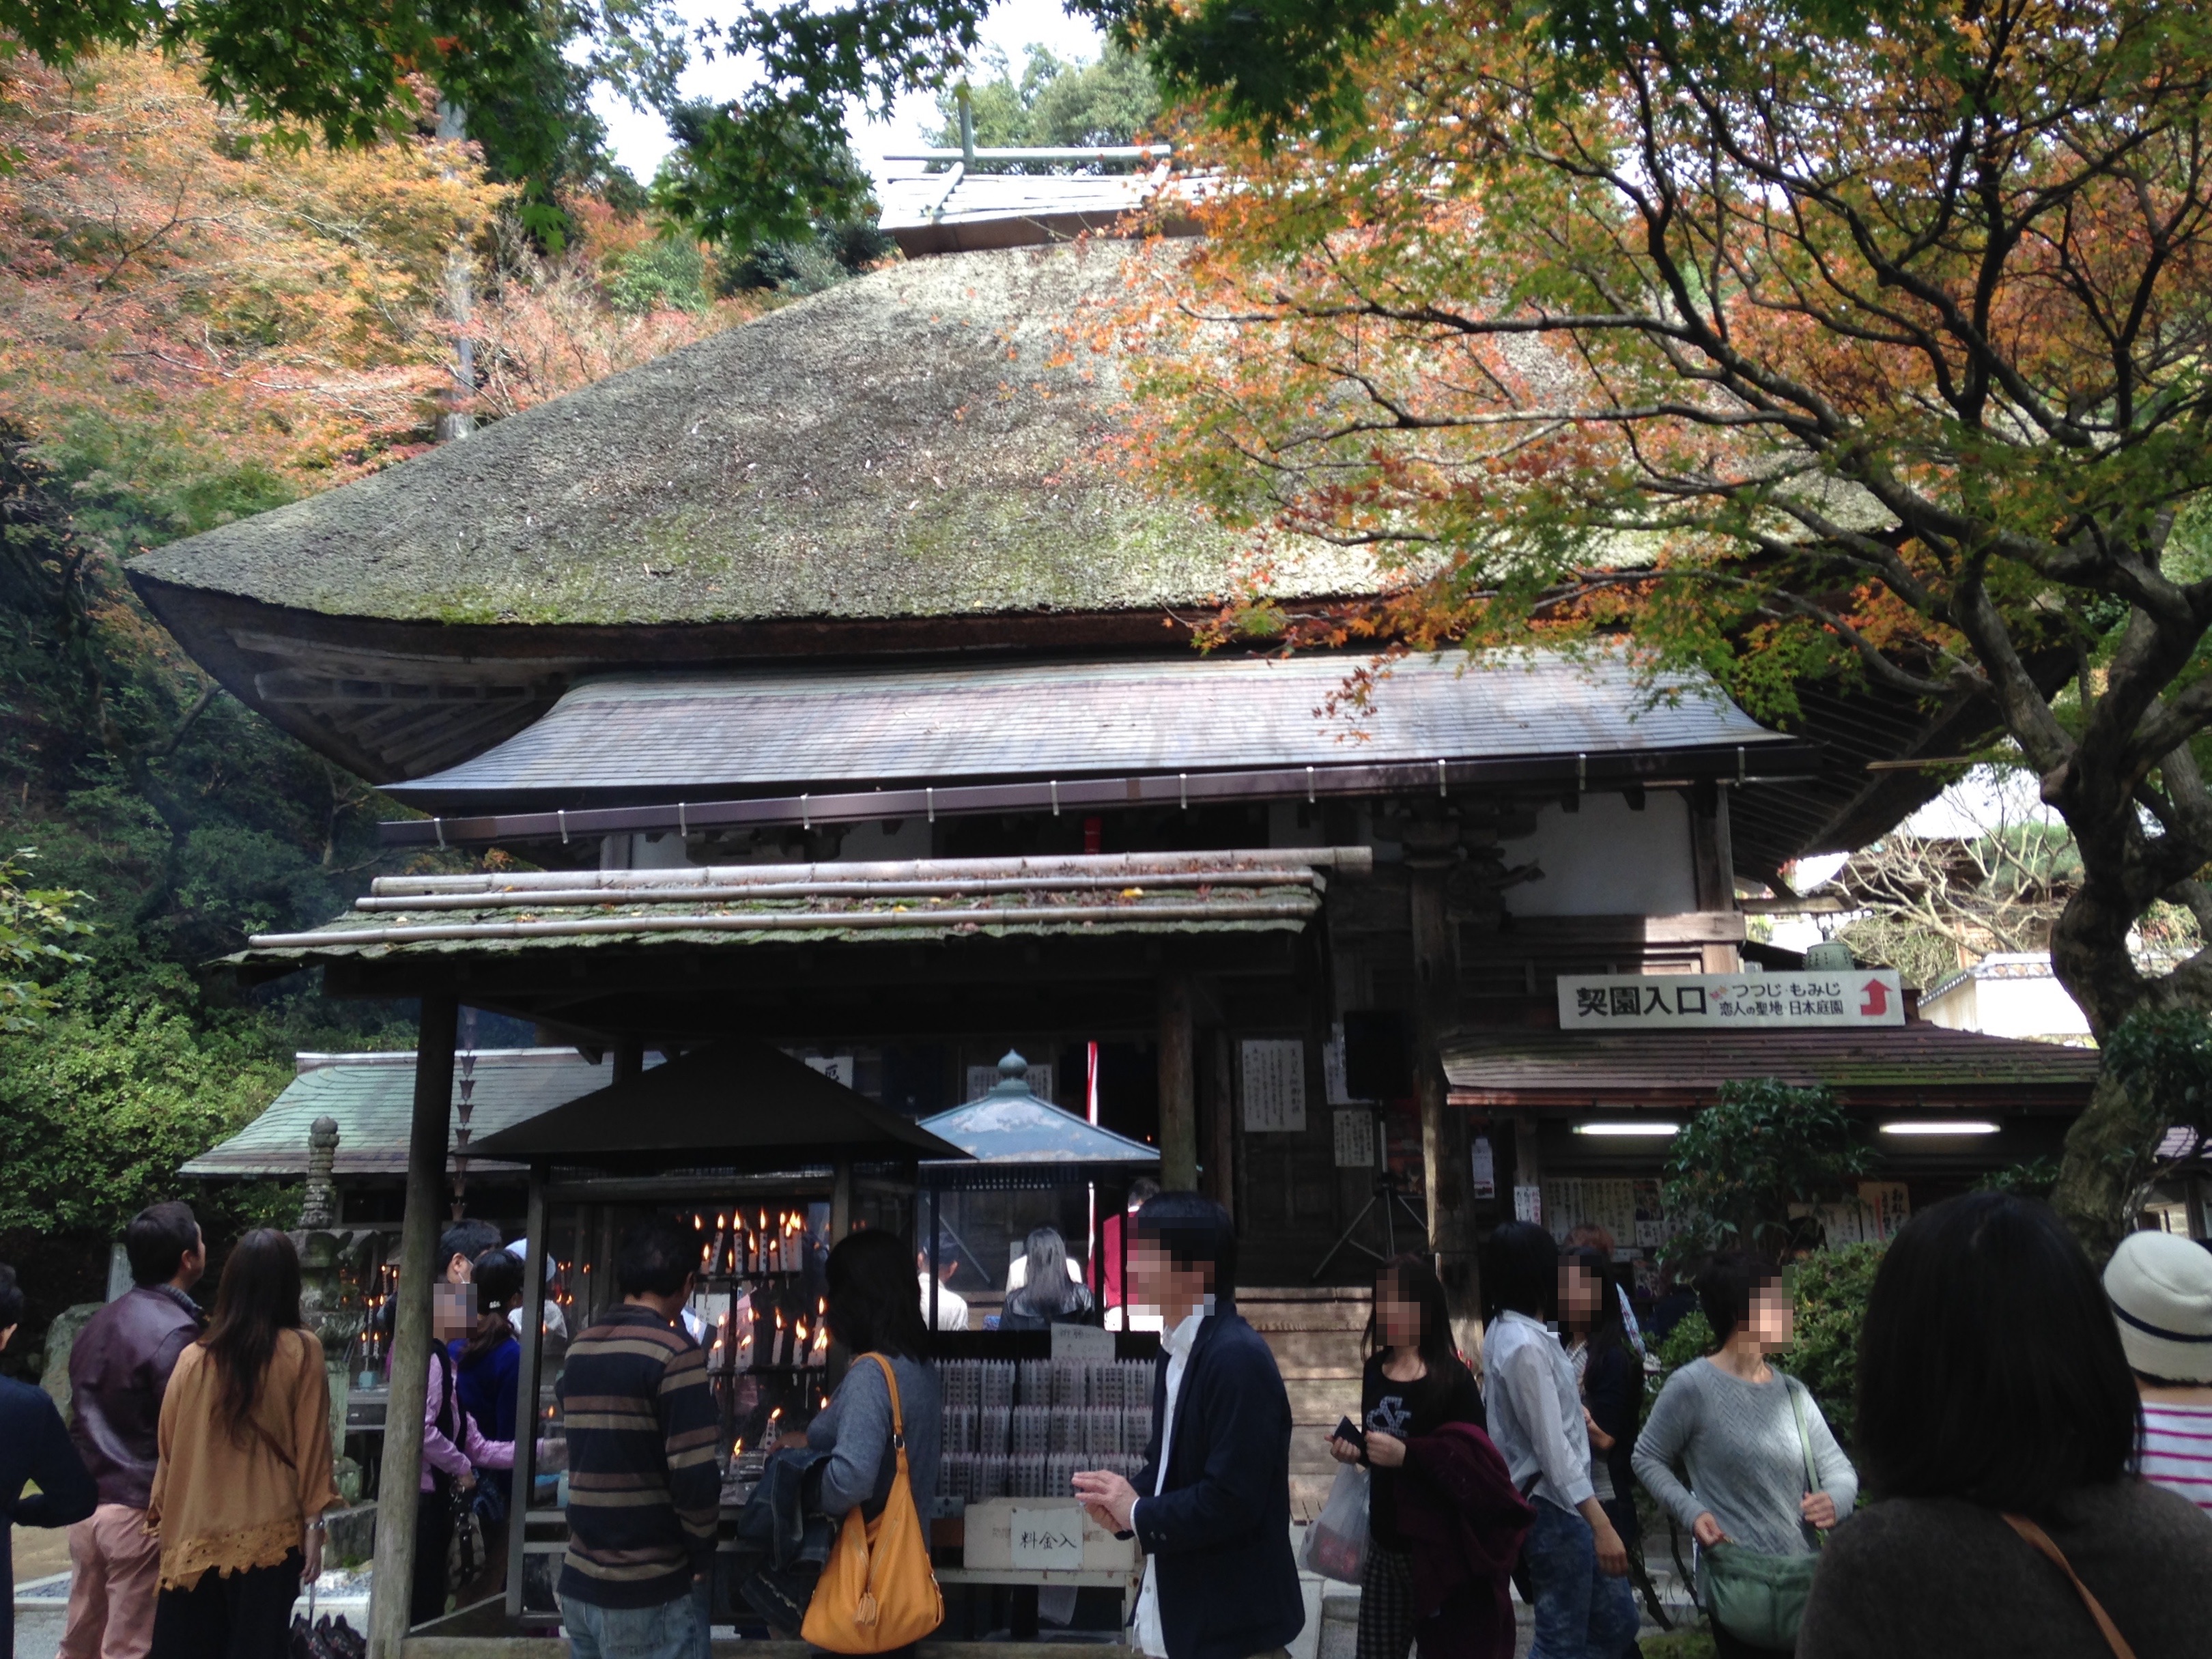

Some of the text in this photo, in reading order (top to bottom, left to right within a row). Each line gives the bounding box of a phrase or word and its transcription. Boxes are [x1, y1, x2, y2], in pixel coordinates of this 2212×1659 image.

[1576, 986, 1707, 1017] 契園入口
[1019, 1531, 1077, 1550] 料金入
